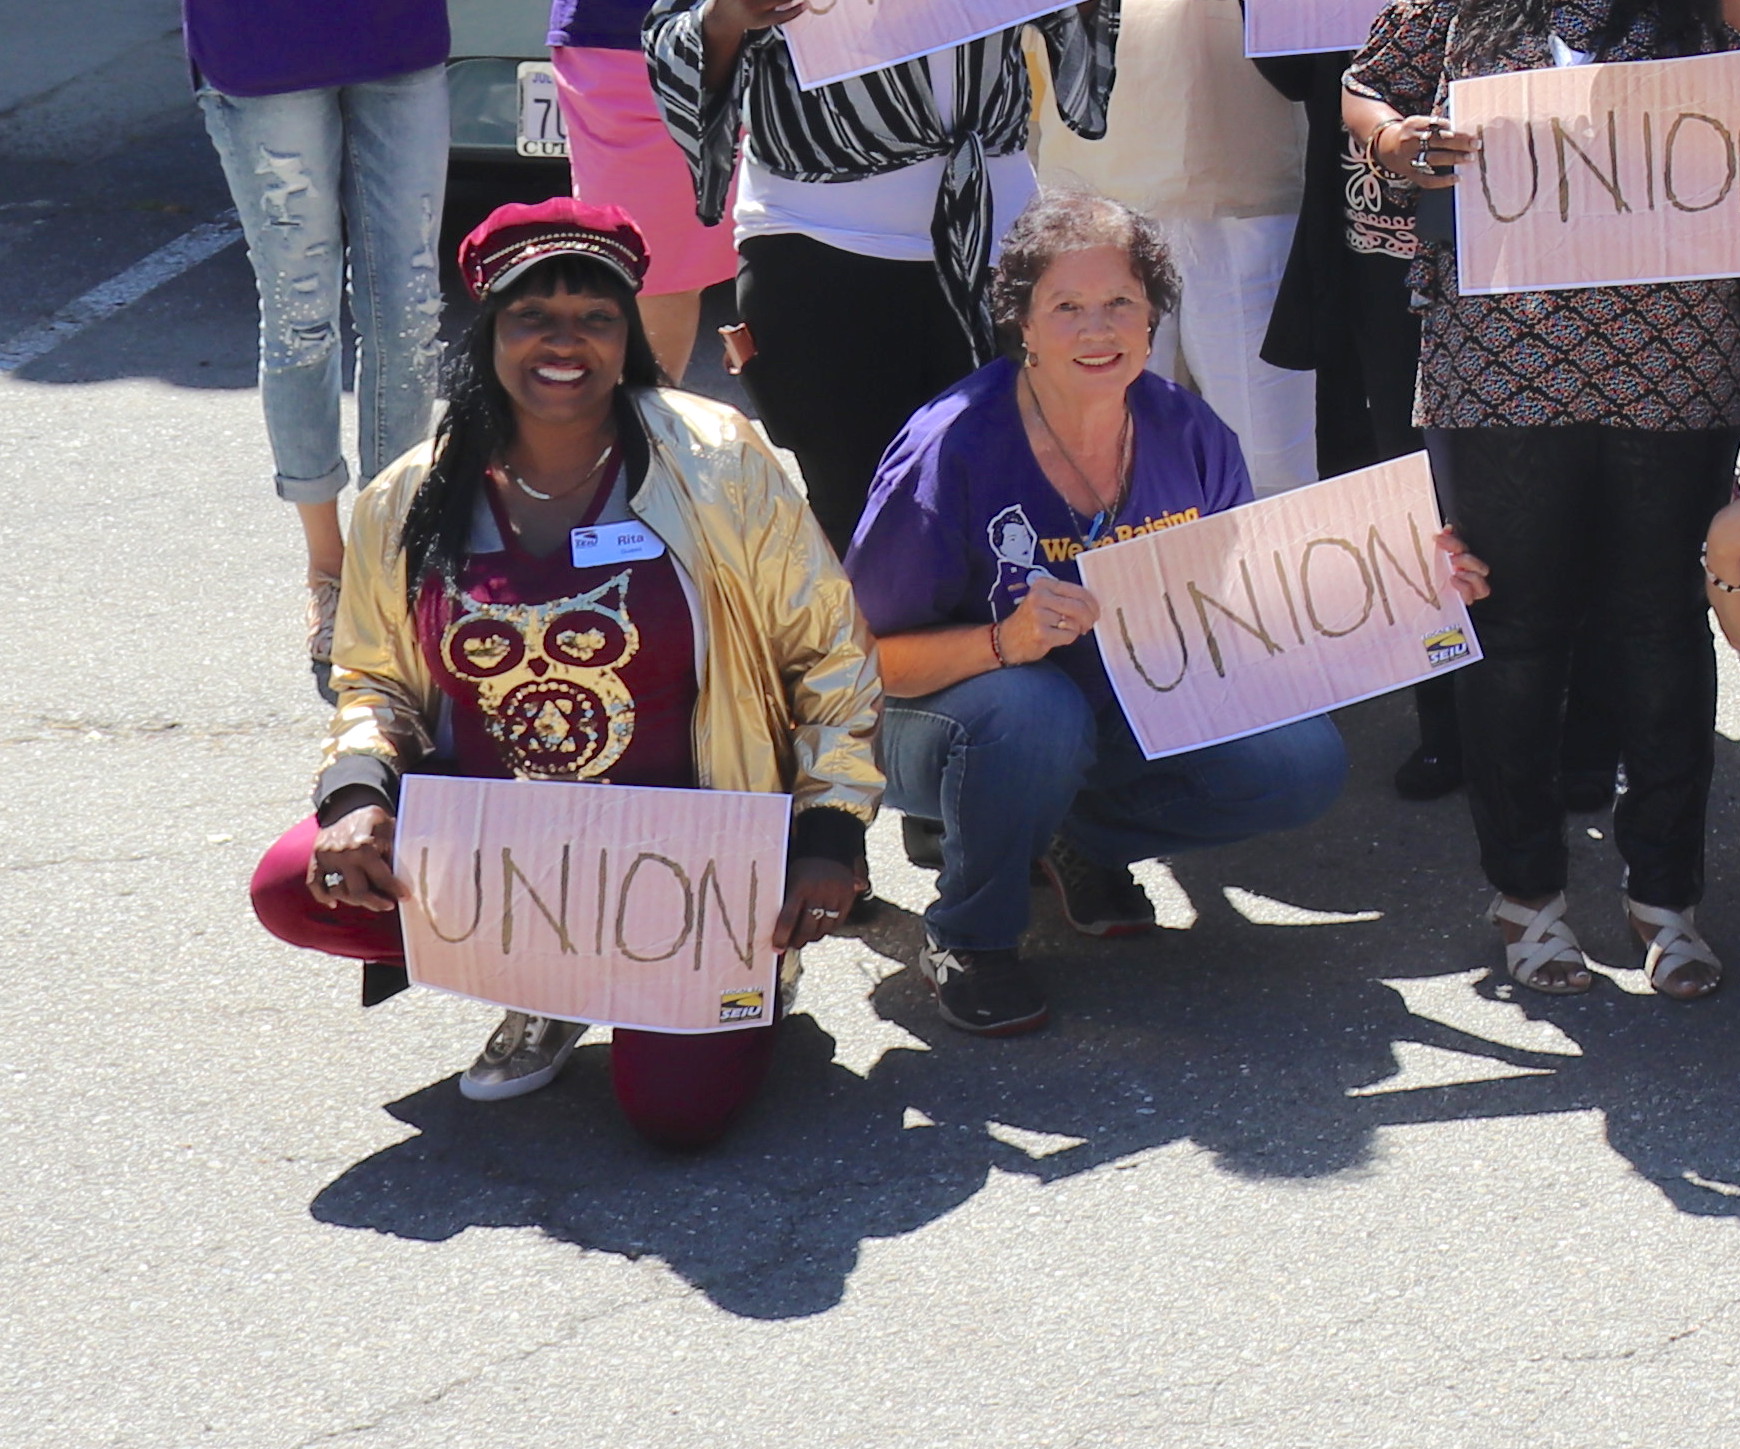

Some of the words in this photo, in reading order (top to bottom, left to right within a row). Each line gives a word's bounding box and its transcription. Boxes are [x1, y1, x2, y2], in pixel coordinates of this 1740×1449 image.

[617, 534, 644, 546] Rita
[1117, 512, 1441, 692] UNION
[1430, 643, 1466, 663] SEIU
[419, 844, 757, 971] UNION
[721, 1007, 761, 1018] SEIU
